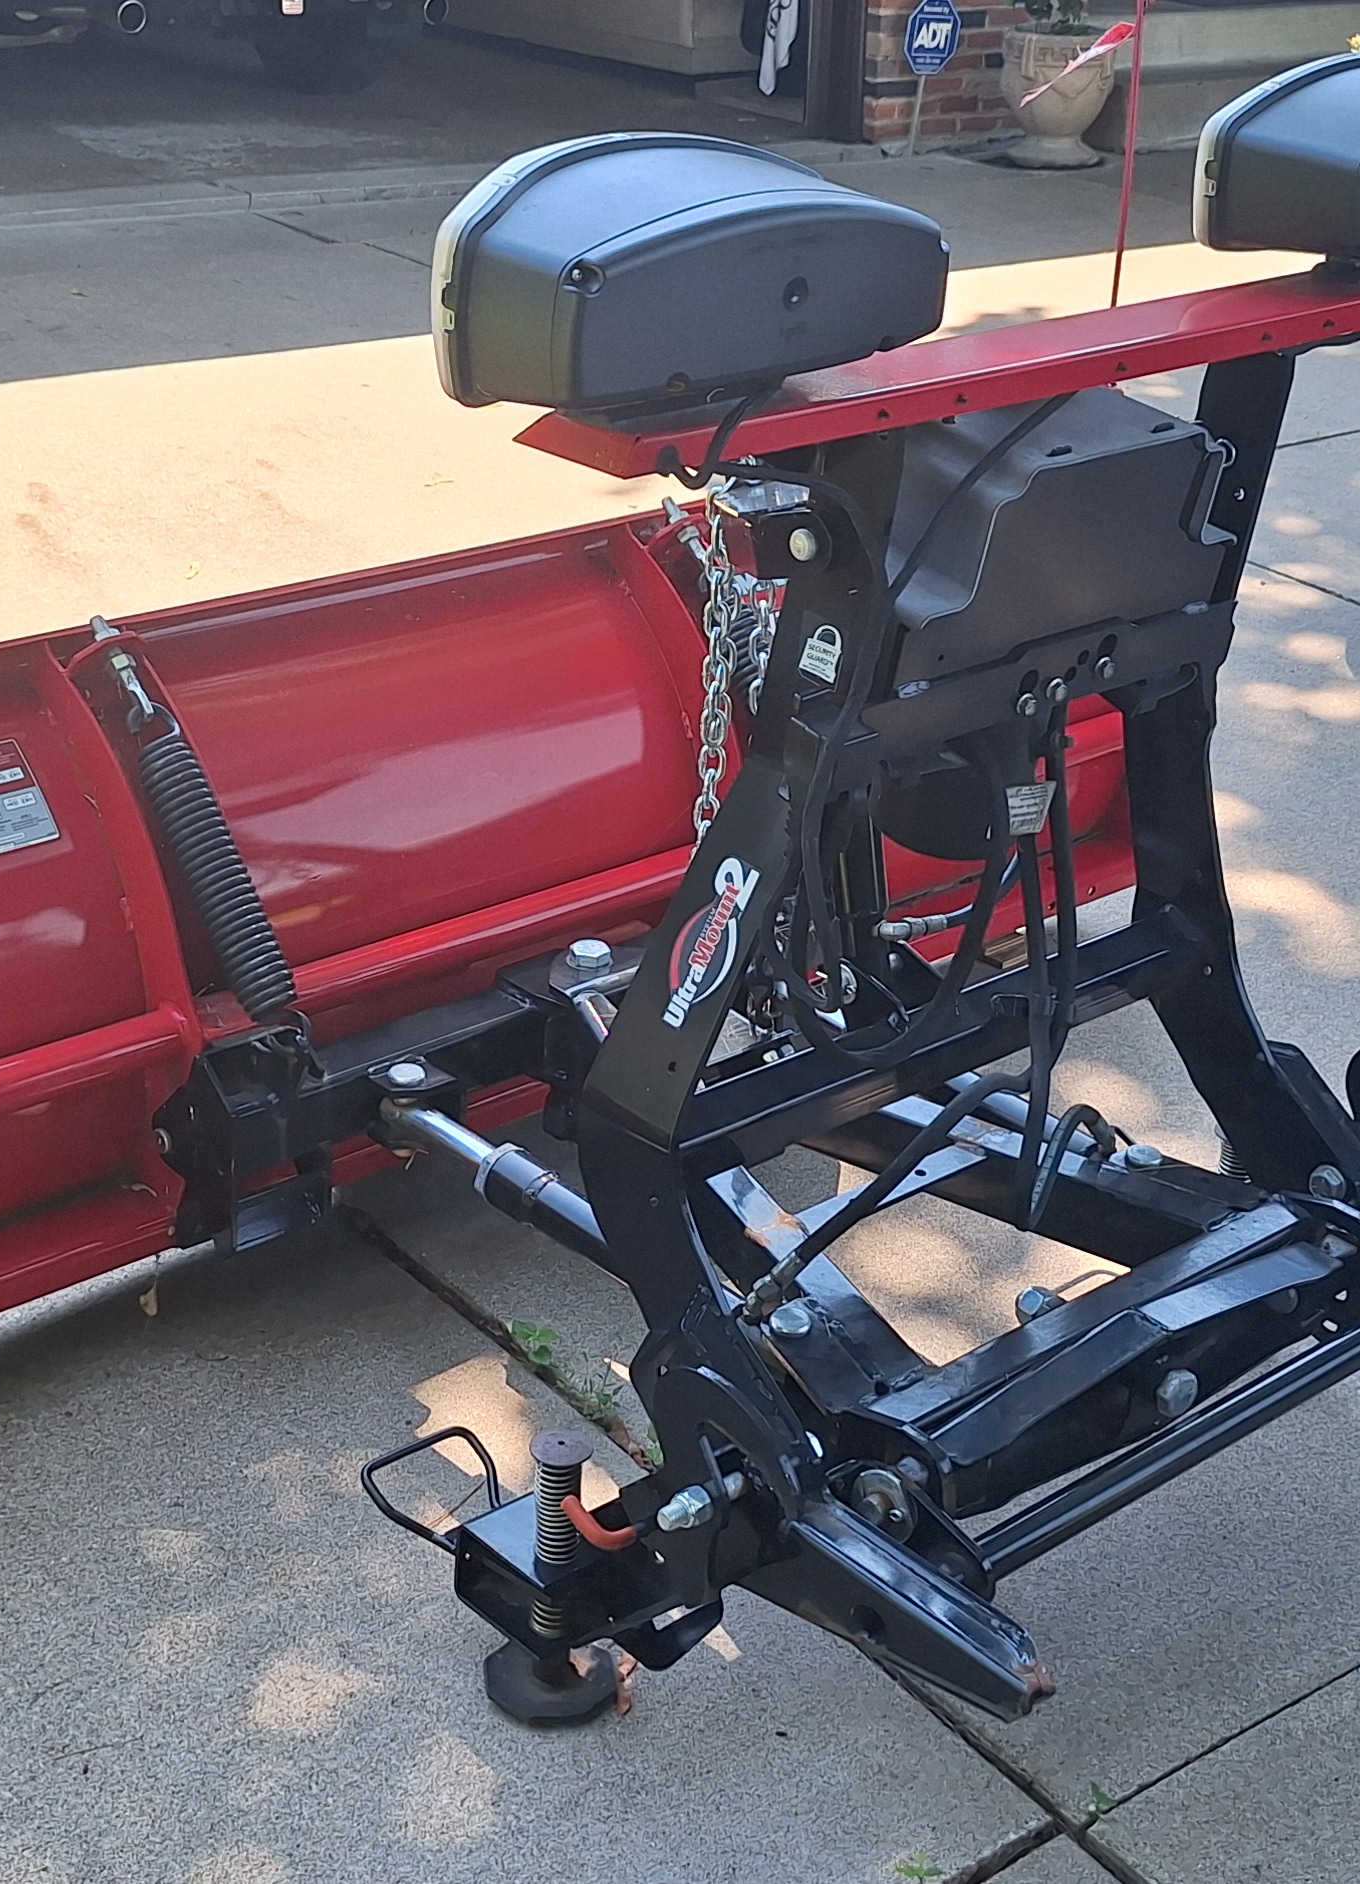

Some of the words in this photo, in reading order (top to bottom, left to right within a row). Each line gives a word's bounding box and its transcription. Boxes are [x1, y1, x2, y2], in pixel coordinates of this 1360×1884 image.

[913, 22, 952, 50] ADT
[807, 643, 836, 659] SECURITY
[698, 907, 716, 939] SYSTEM
[663, 883, 740, 1029] UltraMount
[715, 857, 760, 911] 2
